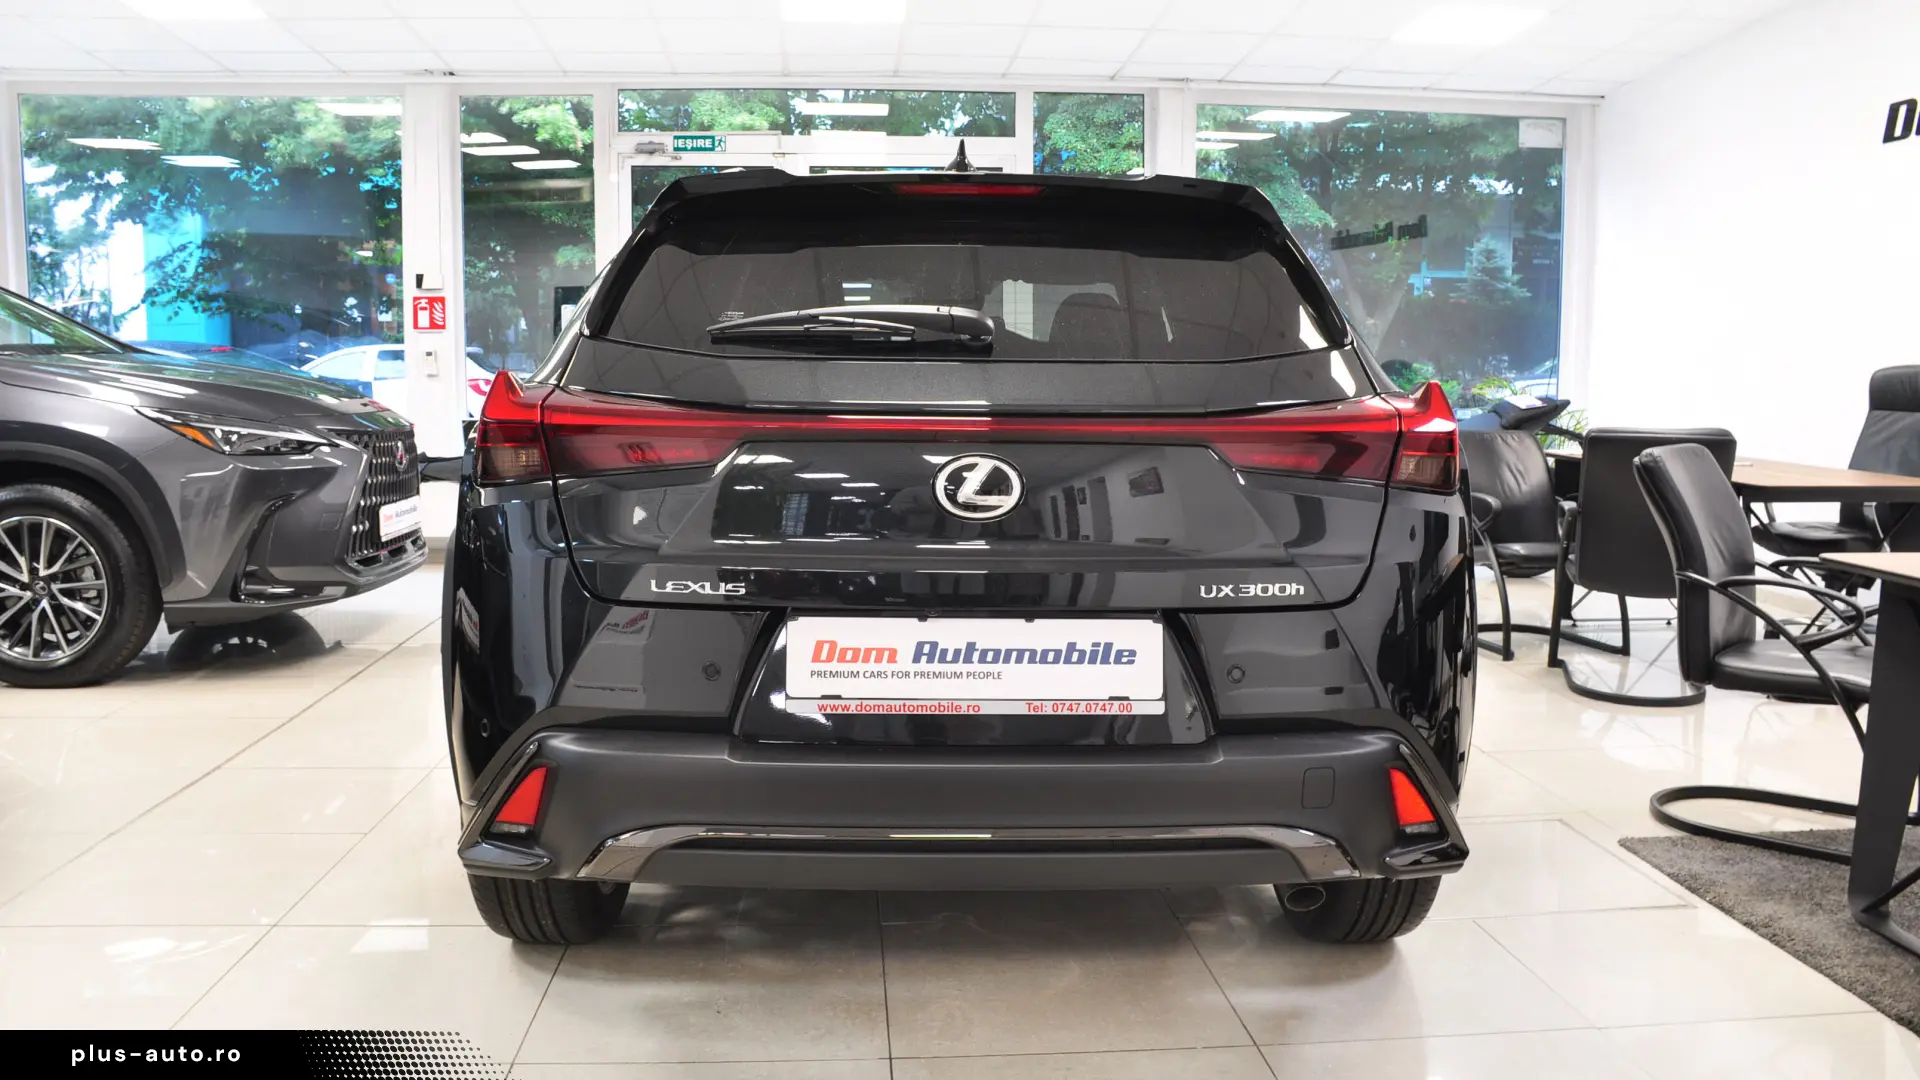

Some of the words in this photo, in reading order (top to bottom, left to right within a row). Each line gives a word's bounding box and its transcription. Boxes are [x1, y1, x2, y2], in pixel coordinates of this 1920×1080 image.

[1883, 98, 1920, 143] D
[650, 579, 746, 596] LEXUS
[1199, 584, 1236, 598] UX
[1238, 583, 1304, 597] 300h
[811, 640, 898, 664] Dom
[911, 640, 1137, 665] Automobile
[810, 670, 860, 679] PREMIUM
[862, 670, 888, 680] CARS
[891, 670, 911, 680] FOR
[913, 671, 963, 680] PREMIUM
[966, 671, 1003, 680] PEOPLE
[817, 701, 981, 713] www.domautomobile.ro
[1026, 702, 1048, 713] Tel:
[1051, 702, 1133, 713] 0747.0747.00
